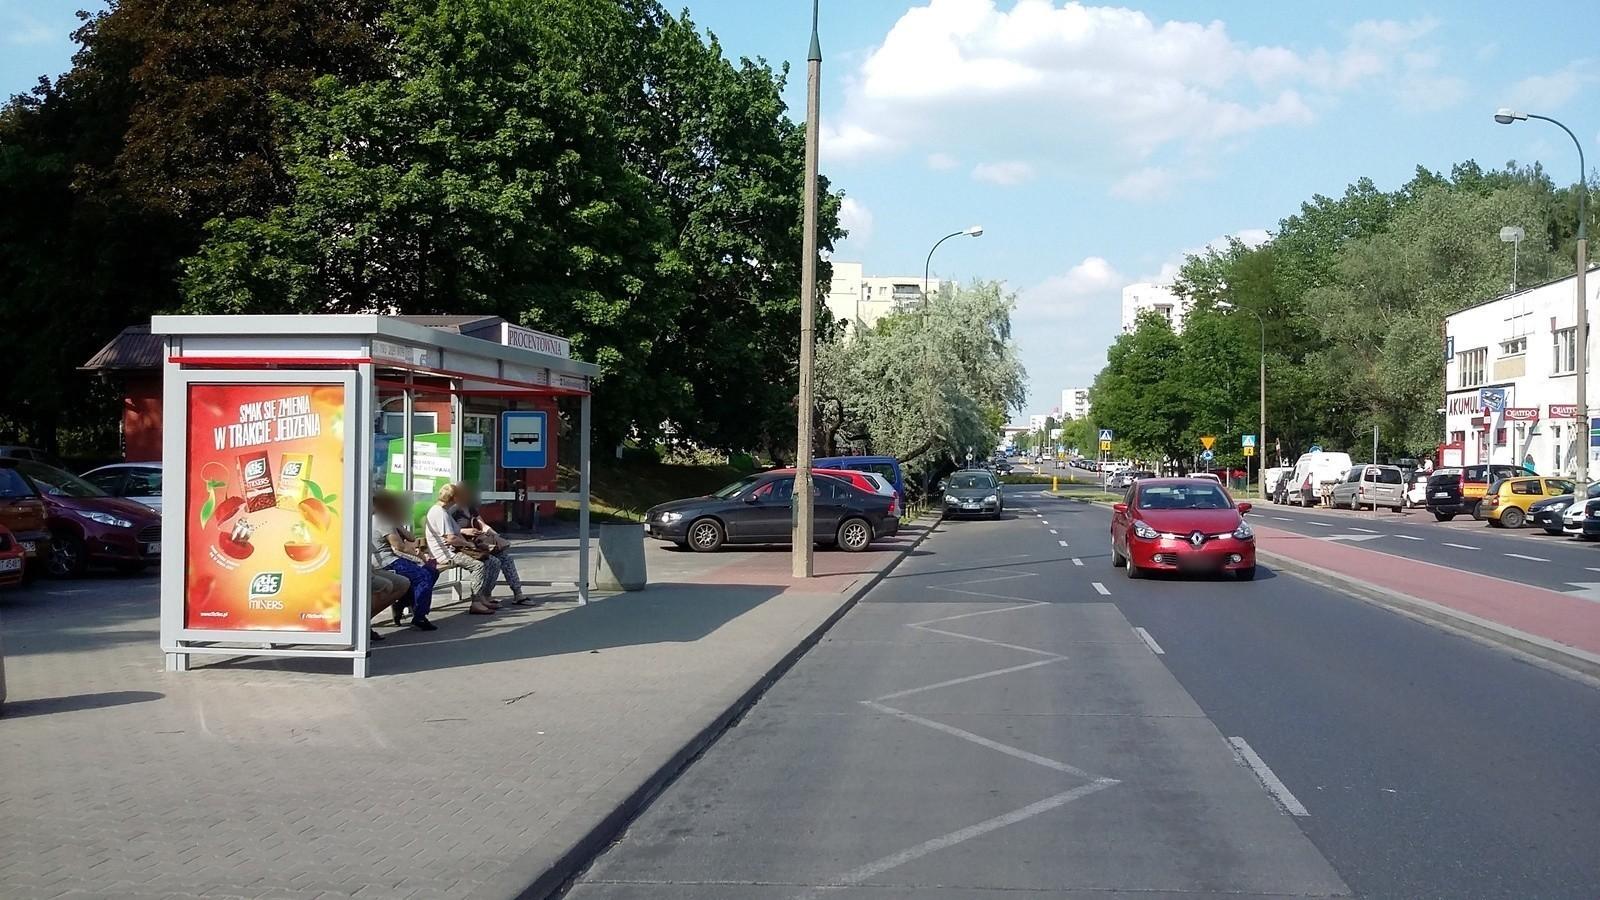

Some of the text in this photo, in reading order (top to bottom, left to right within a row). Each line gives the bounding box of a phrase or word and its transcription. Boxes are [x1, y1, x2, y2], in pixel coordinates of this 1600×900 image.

[509, 330, 562, 356] PROCENTOWNIA
[239, 395, 310, 423] SMAK SIĘ ZMIENIA
[1449, 396, 1479, 416] AKUMUL
[1505, 410, 1537, 419] QUATTRO
[214, 413, 320, 451] W TRAKCIE JEDZENIA
[256, 583, 278, 593] tac
[257, 574, 280, 585] tic
